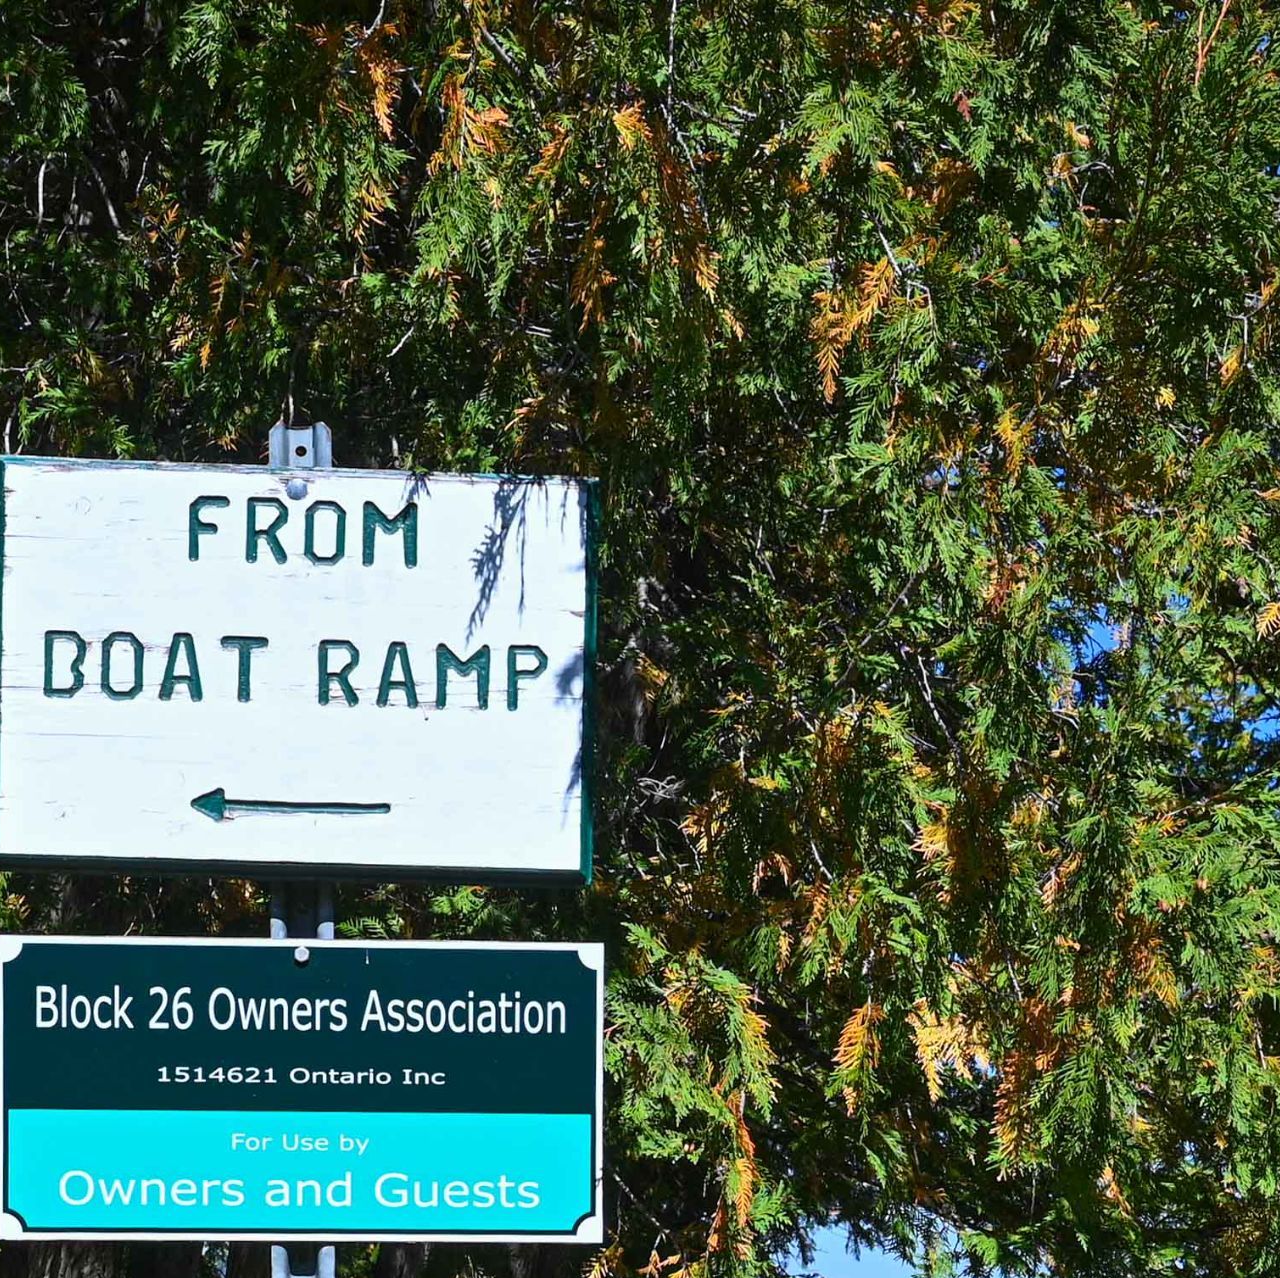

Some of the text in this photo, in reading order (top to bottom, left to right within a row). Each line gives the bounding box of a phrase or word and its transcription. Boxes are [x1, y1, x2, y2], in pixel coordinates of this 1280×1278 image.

[188, 495, 418, 568] FROM
[43, 630, 549, 711] BOAT RAMP
[35, 984, 567, 1034] Block 26 Owners Association
[157, 1066, 446, 1086] 1514621 Ontario Inc
[231, 1133, 370, 1155] For Use by
[58, 1169, 541, 1209] Owners and Guests
